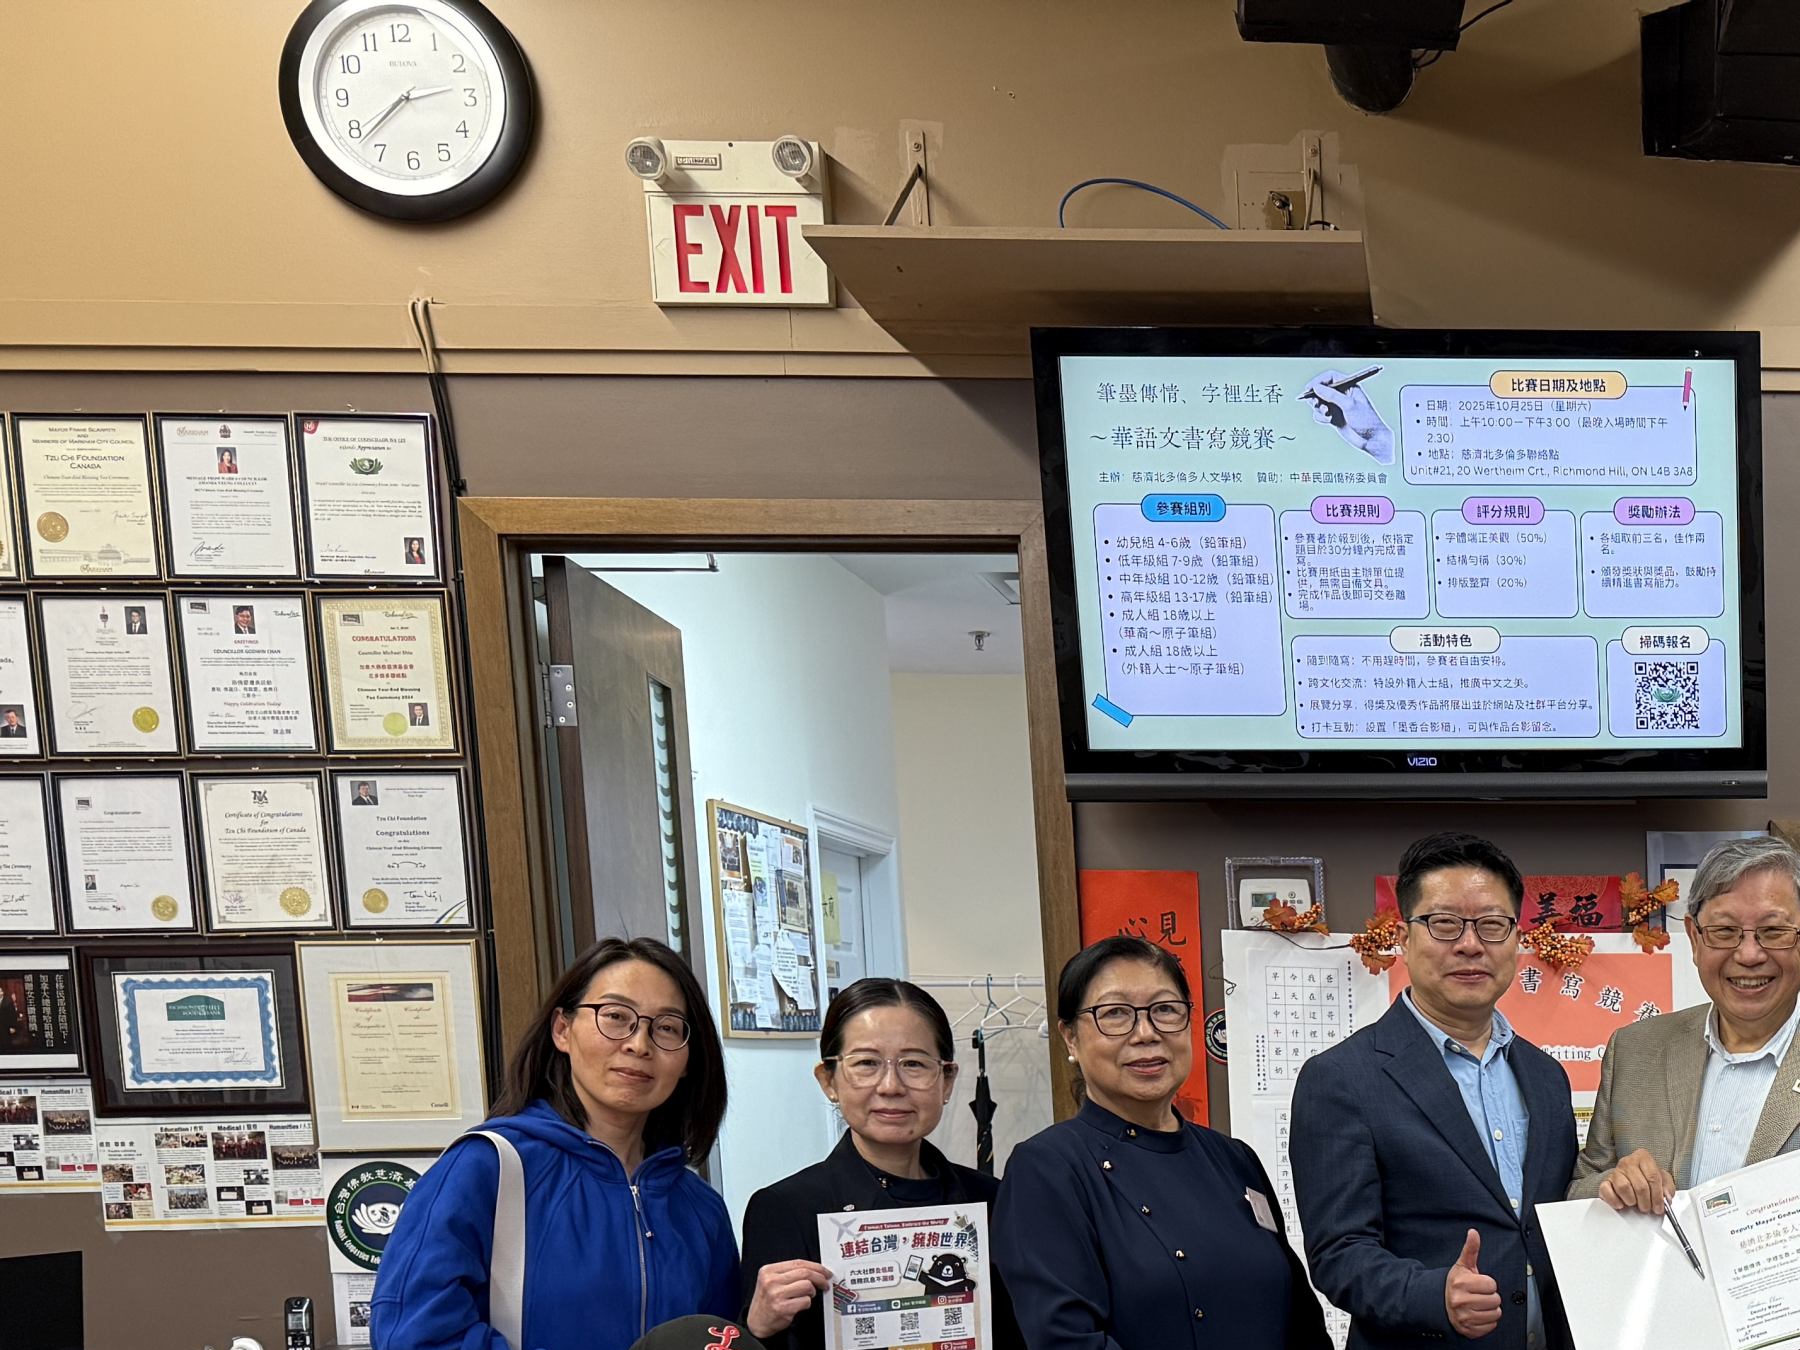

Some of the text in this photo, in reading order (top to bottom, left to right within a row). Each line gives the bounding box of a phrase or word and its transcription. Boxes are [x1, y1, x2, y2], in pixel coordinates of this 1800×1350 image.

[388, 24, 411, 42] 12
[361, 33, 377, 51] 11
[432, 33, 437, 51] 1
[339, 54, 360, 74] 10
[452, 54, 466, 72] 2
[336, 88, 349, 107] 9
[464, 89, 477, 106] 3
[349, 120, 361, 138] 8
[456, 120, 469, 138] 4
[374, 144, 386, 162] 7
[407, 151, 420, 170] 6
[438, 143, 450, 161] 5
[673, 205, 797, 294] EXIT
[1096, 382, 1284, 404] 筆墨傳情、字裡生香
[1511, 378, 1606, 393] 比賽日期及地點
[1410, 466, 1454, 477] Unit#21,
[1457, 466, 1470, 476] 20
[1474, 466, 1525, 476] Wertheim
[1553, 466, 1606, 476] Richmond
[1608, 466, 1628, 477] Hill,
[1632, 466, 1648, 476] ON
[1651, 466, 1670, 476] L4B
[1673, 466, 1693, 476] 3A8
[1156, 502, 1211, 516] 參賽組別
[1326, 504, 1380, 518] 比賽規則
[1477, 505, 1530, 518] 評分規則
[1628, 506, 1680, 519] 獎勵辦法
[1116, 537, 1154, 549] 幼兒組
[1118, 555, 1169, 567] 低年級組
[1119, 573, 1170, 585] 中年級組
[1121, 591, 1171, 603] 高年級組
[1122, 609, 1216, 621] 成人組 18歲以上
[1419, 633, 1473, 648] 活動特色
[1639, 635, 1691, 649] 掃碼報名
[1125, 645, 1218, 657] 成人組 18歲以上
[1408, 757, 1437, 766] VIZIO
[1158, 912, 1186, 945] 見
[1730, 1224, 1753, 1235] Deputy
[1756, 1216, 1776, 1226] Mayor
[840, 1232, 968, 1259] 連結台灣，擁抱世界
